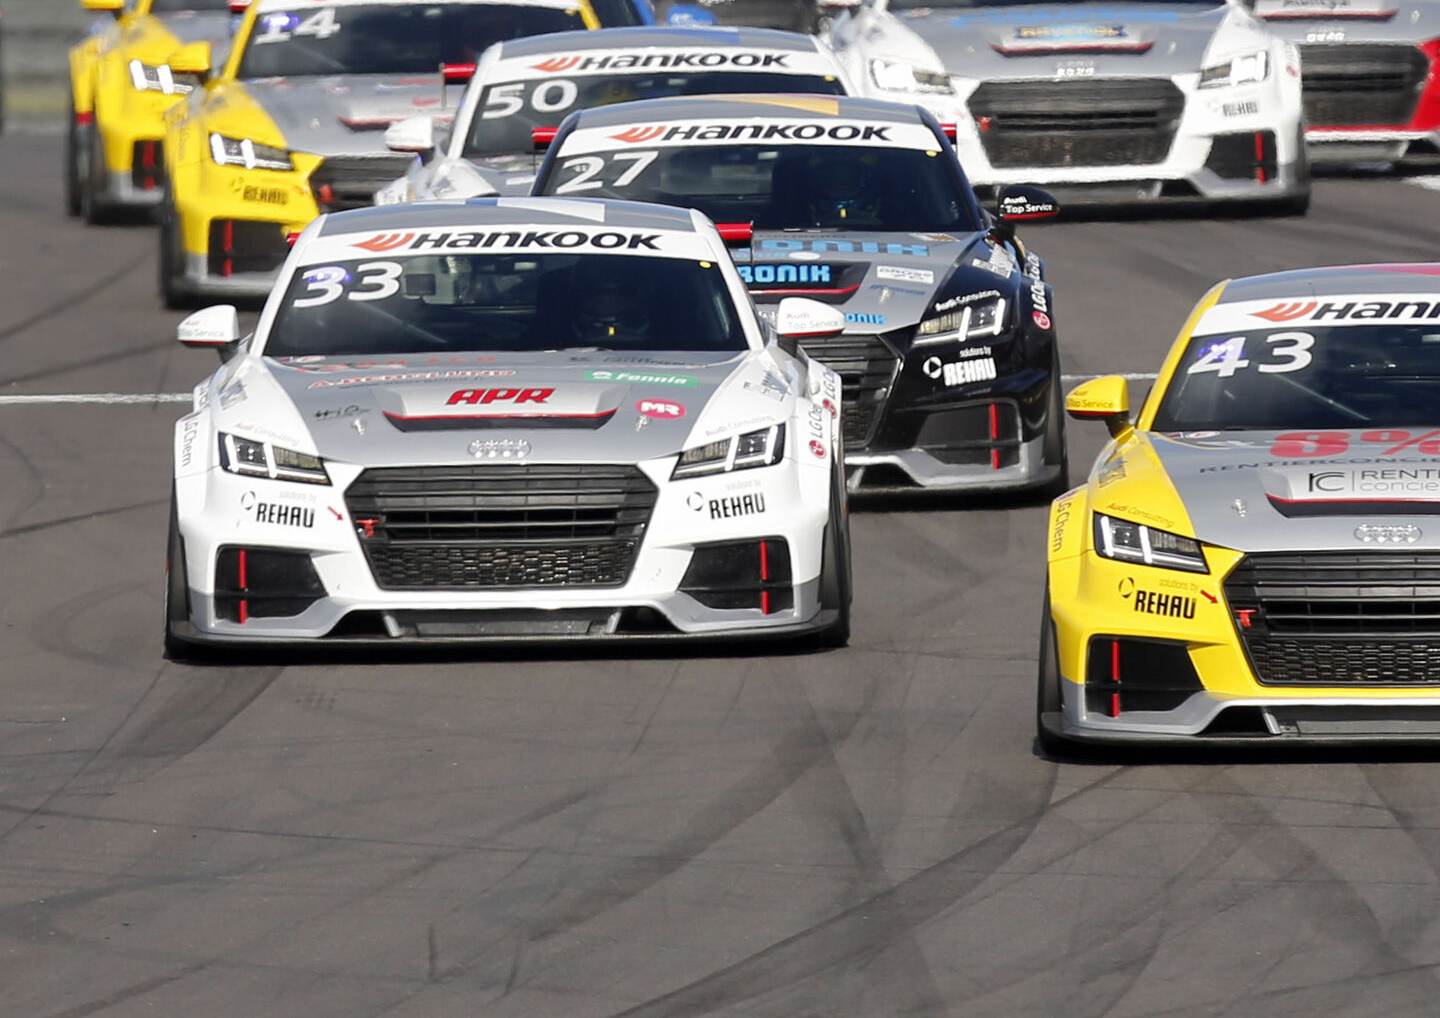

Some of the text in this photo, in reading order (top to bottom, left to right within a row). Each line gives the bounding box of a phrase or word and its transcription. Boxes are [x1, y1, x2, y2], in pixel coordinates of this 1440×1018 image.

[482, 80, 579, 120] 50
[555, 149, 659, 194] 27
[1003, 195, 1028, 205] Audi
[1004, 203, 1053, 214] Top Service
[292, 260, 403, 309] 33
[787, 319, 840, 331] Top Service
[1187, 331, 1316, 378] 43
[614, 372, 689, 385] Fennia
[943, 356, 998, 387] REHAU
[446, 387, 557, 406] APR
[640, 401, 682, 417] MR
[181, 429, 198, 468] Chem
[256, 501, 317, 529] REHAU
[708, 492, 767, 521] REHAU
[1052, 513, 1071, 554] Chem
[1134, 589, 1198, 621] REHAU
